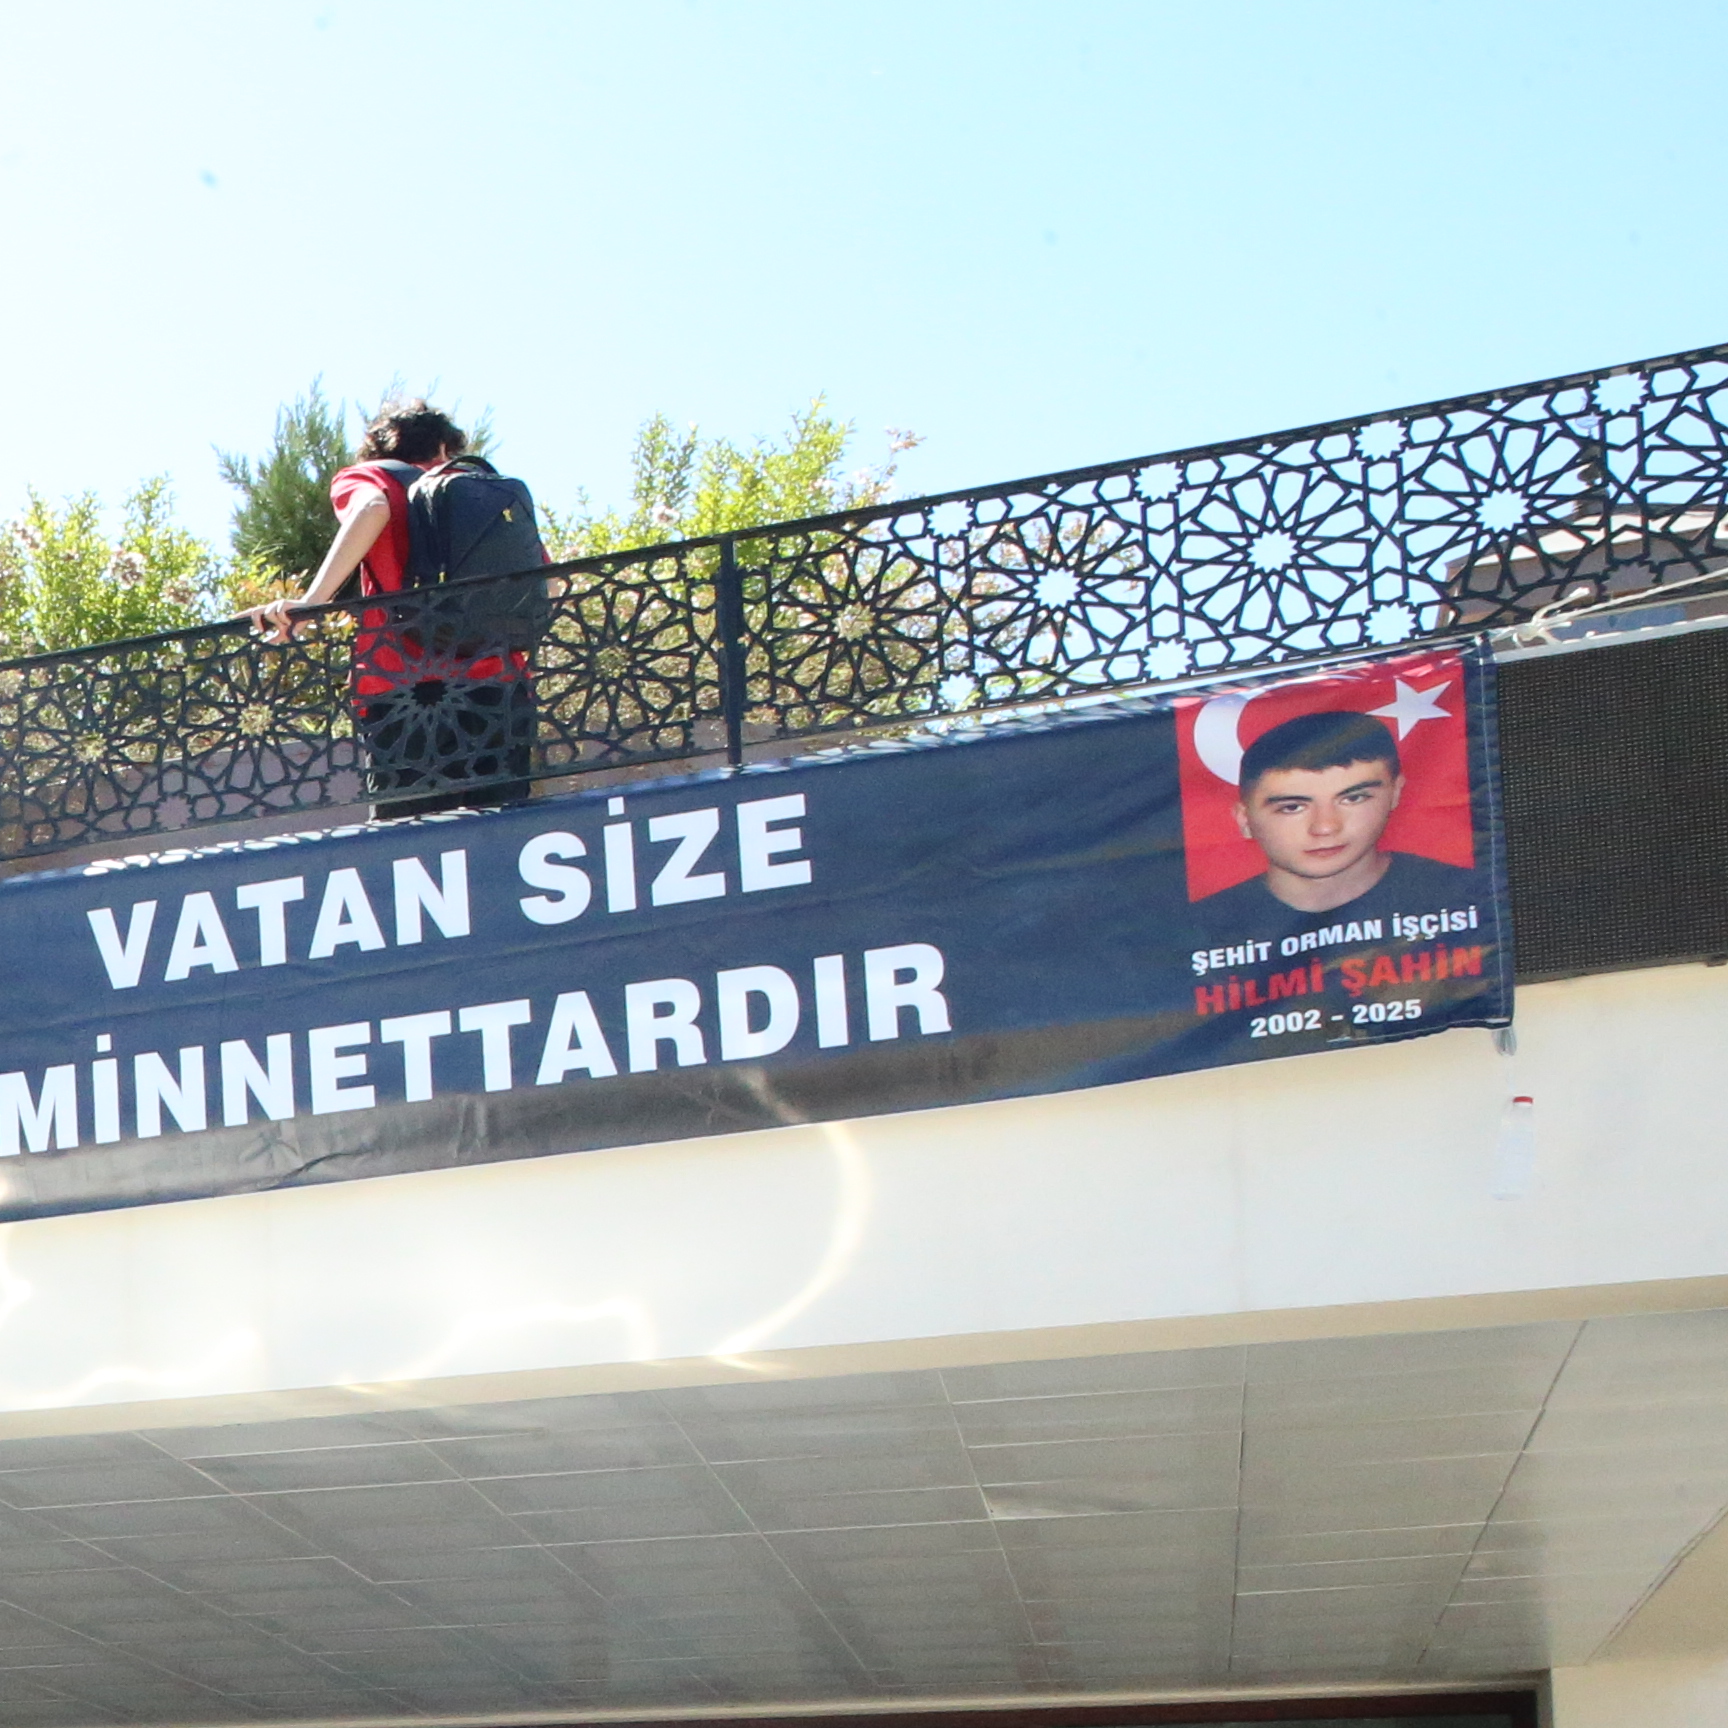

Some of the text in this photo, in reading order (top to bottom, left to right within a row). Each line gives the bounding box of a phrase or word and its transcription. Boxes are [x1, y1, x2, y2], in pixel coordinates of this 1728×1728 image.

[86, 792, 813, 991] VATAN SİZE
[1191, 906, 1479, 977] ŞEHİT ORMAN İŞÇİSİ
[1195, 943, 1483, 1016] HİLMİ ŞAHİN
[1250, 1009, 1322, 1038] 2002
[1351, 999, 1422, 1025] 2025
